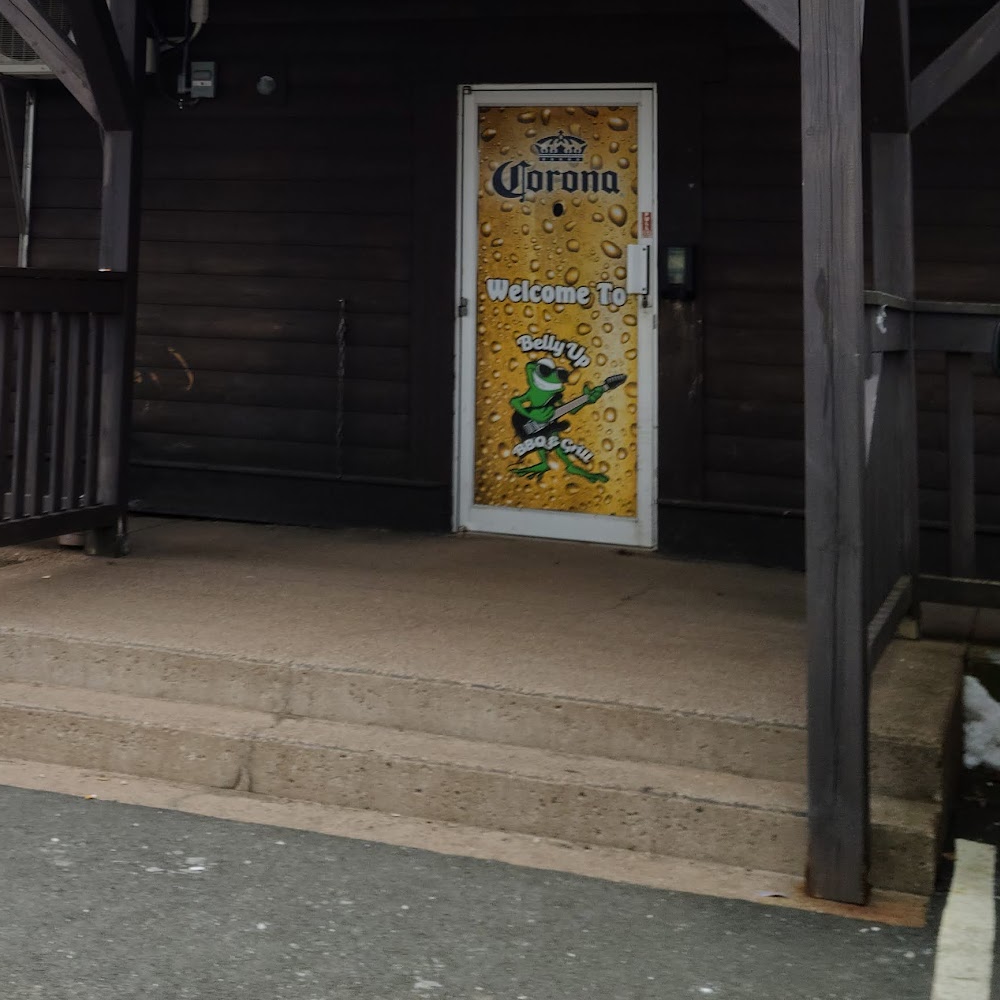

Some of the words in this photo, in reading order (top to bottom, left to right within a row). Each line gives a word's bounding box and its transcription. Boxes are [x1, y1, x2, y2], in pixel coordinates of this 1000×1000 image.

[492, 160, 620, 203] Corona
[486, 278, 591, 306] Welcome
[596, 281, 627, 307] To
[515, 333, 567, 358] Belly
[564, 340, 592, 368] Up
[511, 435, 548, 458] BBQ
[560, 438, 595, 464] Grill
